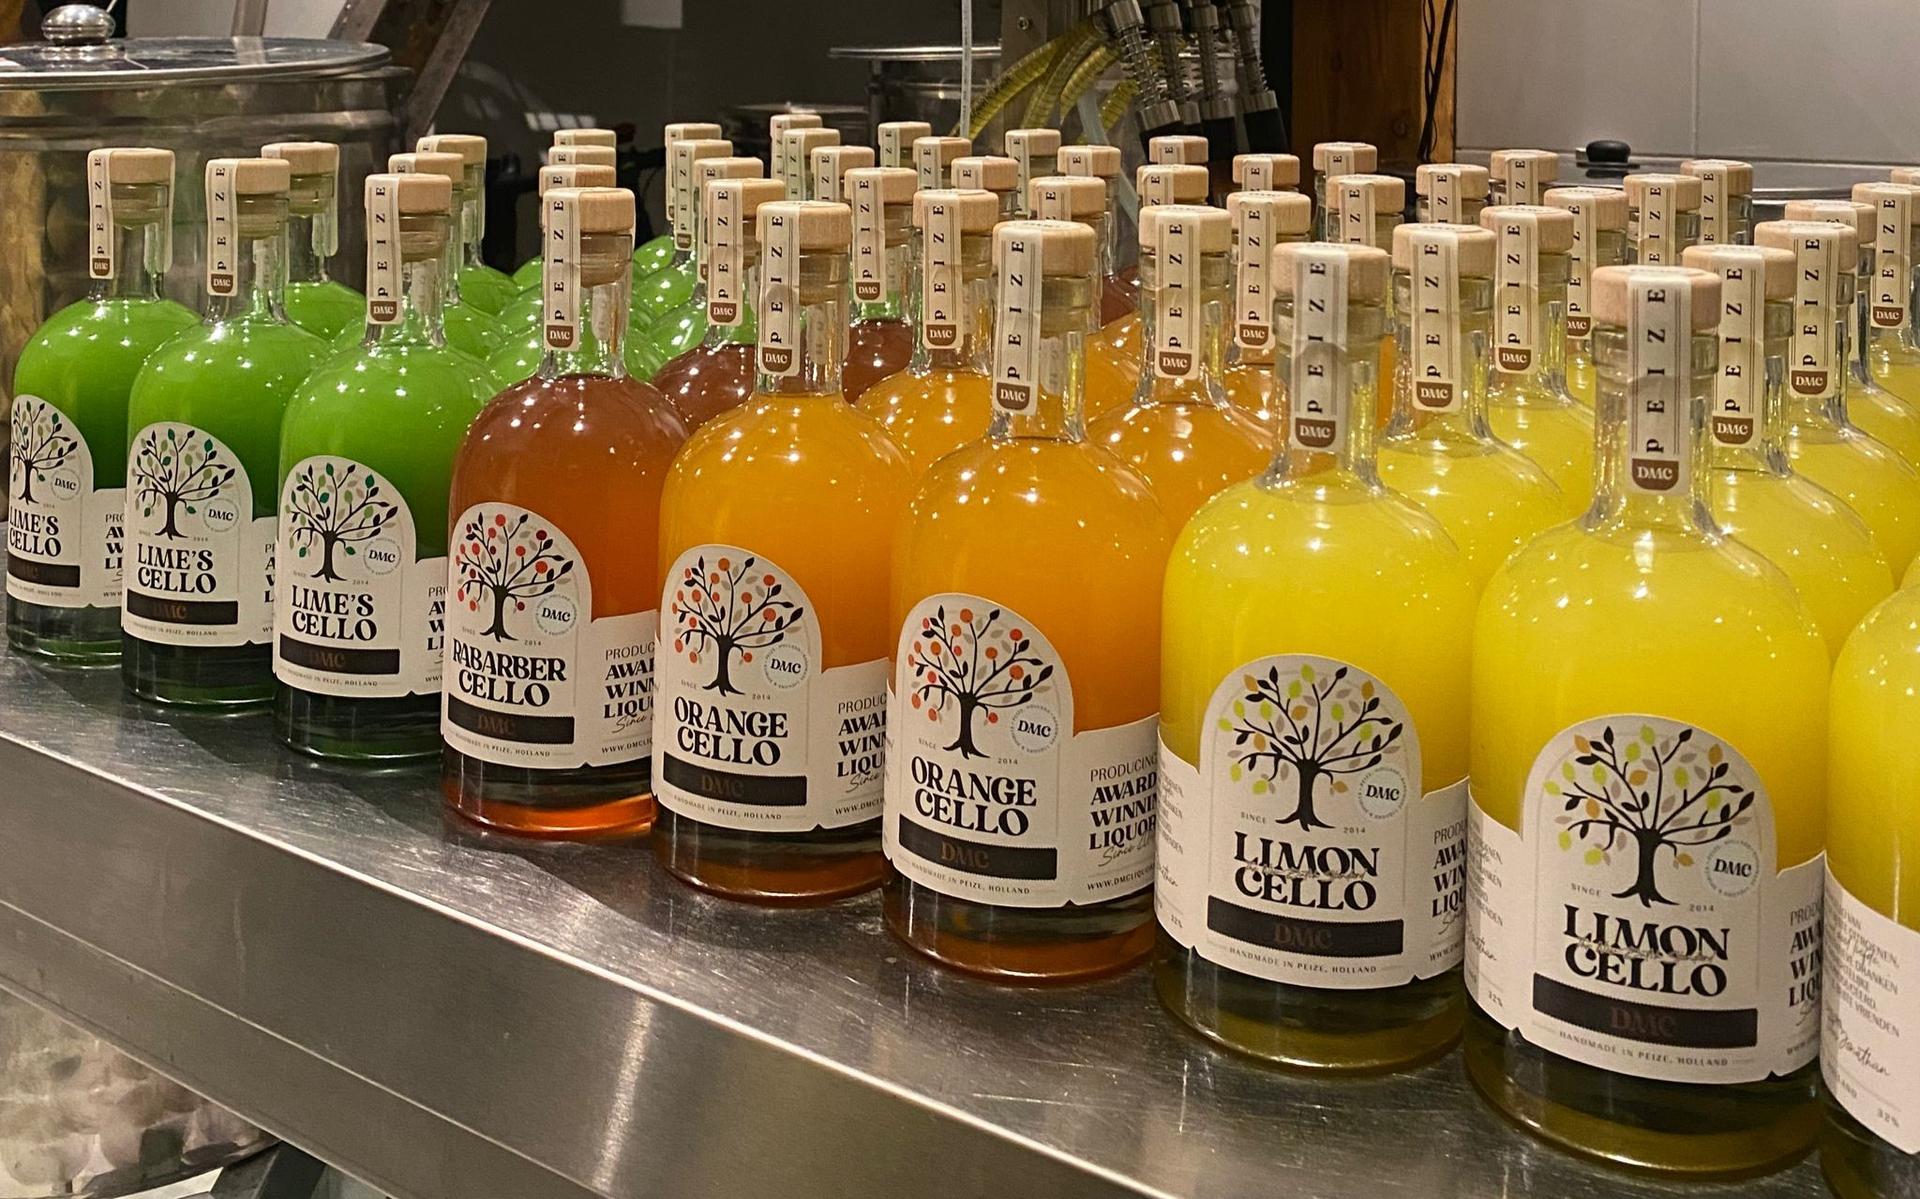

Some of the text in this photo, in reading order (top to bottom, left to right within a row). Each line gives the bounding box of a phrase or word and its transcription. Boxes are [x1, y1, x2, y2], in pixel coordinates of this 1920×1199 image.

[679, 150, 688, 230] PEIZE
[94, 158, 105, 255] PEIZE
[215, 168, 227, 271] PEIZE
[1703, 173, 1714, 242] EIZE
[859, 180, 872, 279] PEIZE
[1649, 186, 1661, 262] EIZE
[375, 187, 389, 297] PEIZE
[718, 190, 729, 299] PEIZE
[1881, 199, 1896, 303] PEIZE
[554, 200, 565, 321] PEIZE
[933, 204, 947, 321] PEIZE
[1248, 210, 1260, 321] PEIZE
[1569, 205, 1580, 312] PEIZE
[213, 278, 231, 287] DMC
[770, 215, 784, 344] PEIZE
[858, 286, 879, 294] DMC
[1168, 223, 1182, 348] PEIZE
[1507, 225, 1521, 345] PEIZE
[373, 306, 394, 314] DMC
[713, 307, 734, 316] DMC
[1007, 241, 1025, 379] PEIZE
[1425, 244, 1441, 377] PEIZE
[1802, 239, 1820, 365] PEIZE
[1876, 310, 1900, 320] DMC
[550, 330, 571, 340] DMC
[929, 329, 952, 338] DMC
[1243, 329, 1265, 339] DMC
[1307, 262, 1326, 414] PEIZE
[1724, 268, 1743, 412] PEIZE
[765, 353, 788, 365] DMC
[1163, 357, 1188, 369] DMC
[1502, 353, 1528, 363] DMC
[1646, 288, 1666, 453] PEIZE
[1000, 388, 1026, 401] DMC
[1420, 387, 1448, 399] DMC
[1796, 375, 1823, 387] DMC
[1299, 425, 1331, 439] DMC
[1717, 423, 1748, 435] DMC
[54, 477, 77, 491] DMC
[1637, 465, 1673, 480] DMC
[208, 508, 234, 522] DMC
[9, 528, 62, 557] CELLO
[368, 550, 396, 563] DMC
[138, 543, 213, 571] LIME'S
[138, 566, 217, 594] CELLO
[291, 584, 375, 617] LIME'S
[541, 607, 571, 622] DMC
[292, 610, 378, 641] CELLO
[452, 637, 567, 682] RABARBER
[605, 641, 655, 661] PRODUC
[605, 658, 654, 680] AWA
[769, 658, 802, 674] DMC
[458, 669, 551, 707] CELLO
[605, 677, 655, 699] WINN
[674, 696, 788, 738] ORANGE
[838, 692, 887, 715] PRODUC
[611, 714, 647, 734] Since
[838, 709, 887, 736] AWA
[1016, 720, 1051, 738] DMC
[515, 750, 551, 758] HOLLAND
[677, 726, 781, 766] CELLO
[838, 731, 887, 757] WINN
[918, 737, 1019, 765] SINCE 2014
[845, 773, 880, 793] Since
[911, 756, 1037, 807] ORANGE
[1091, 771, 1157, 805] AWARD
[1365, 784, 1400, 801] DMC
[717, 807, 741, 817] PEIZE,
[743, 811, 782, 820] HOLLAND
[914, 788, 1030, 837] CELLO
[1240, 811, 1366, 834] SINCE 2014
[1098, 844, 1136, 868] Since
[1234, 831, 1380, 878] LIMON
[1433, 838, 1466, 870] AWA
[1713, 858, 1752, 878] DMC
[911, 861, 947, 883] HANDMADE
[959, 881, 985, 892] PEIZE,
[988, 884, 1030, 895] HOLLAND
[1234, 867, 1377, 911] CELLO
[1571, 882, 1714, 913] SINCE 2014
[1273, 922, 1333, 947] DMC
[1563, 903, 1730, 961] LIMON
[1229, 946, 1377, 974] HANDMADE IN PEIZE, HOLLAND
[1564, 942, 1727, 998] CELLO
[1559, 1030, 1728, 1067] HANDMADE IN PEIZE, HOLLAND
[1876, 1107, 1900, 1128] 32%
